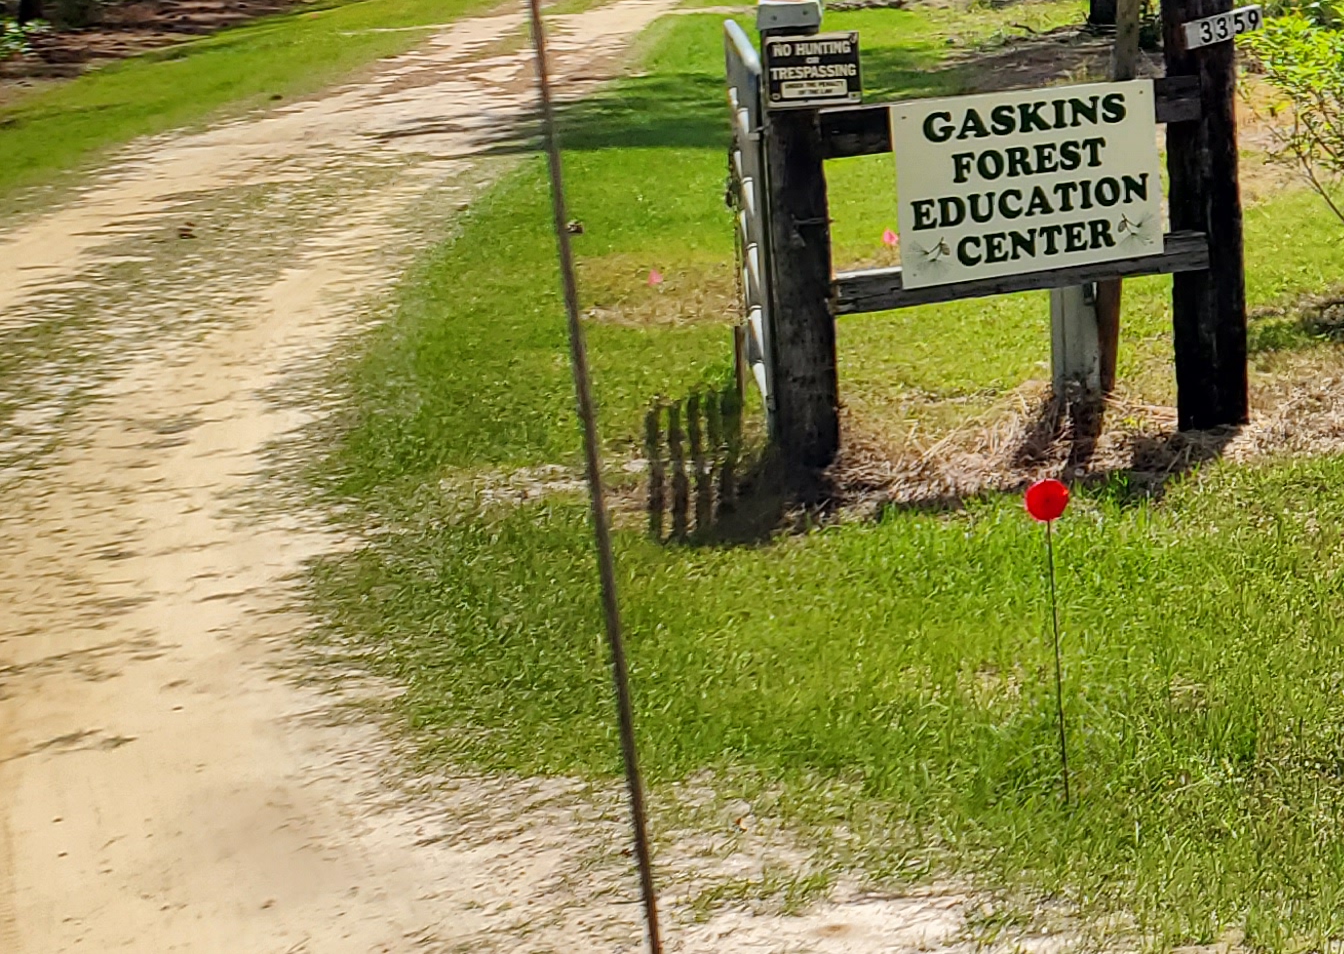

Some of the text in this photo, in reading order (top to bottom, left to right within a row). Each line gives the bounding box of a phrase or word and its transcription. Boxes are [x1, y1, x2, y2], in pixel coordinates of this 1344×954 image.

[773, 41, 852, 57] NO HUNTING
[1200, 9, 1259, 43] 3359
[769, 63, 857, 80] TRESPASSING
[922, 92, 1127, 143] GASKINS
[951, 136, 1106, 184] FOREST
[910, 172, 1149, 231] EDUCATION
[956, 218, 1116, 267] CENTER
